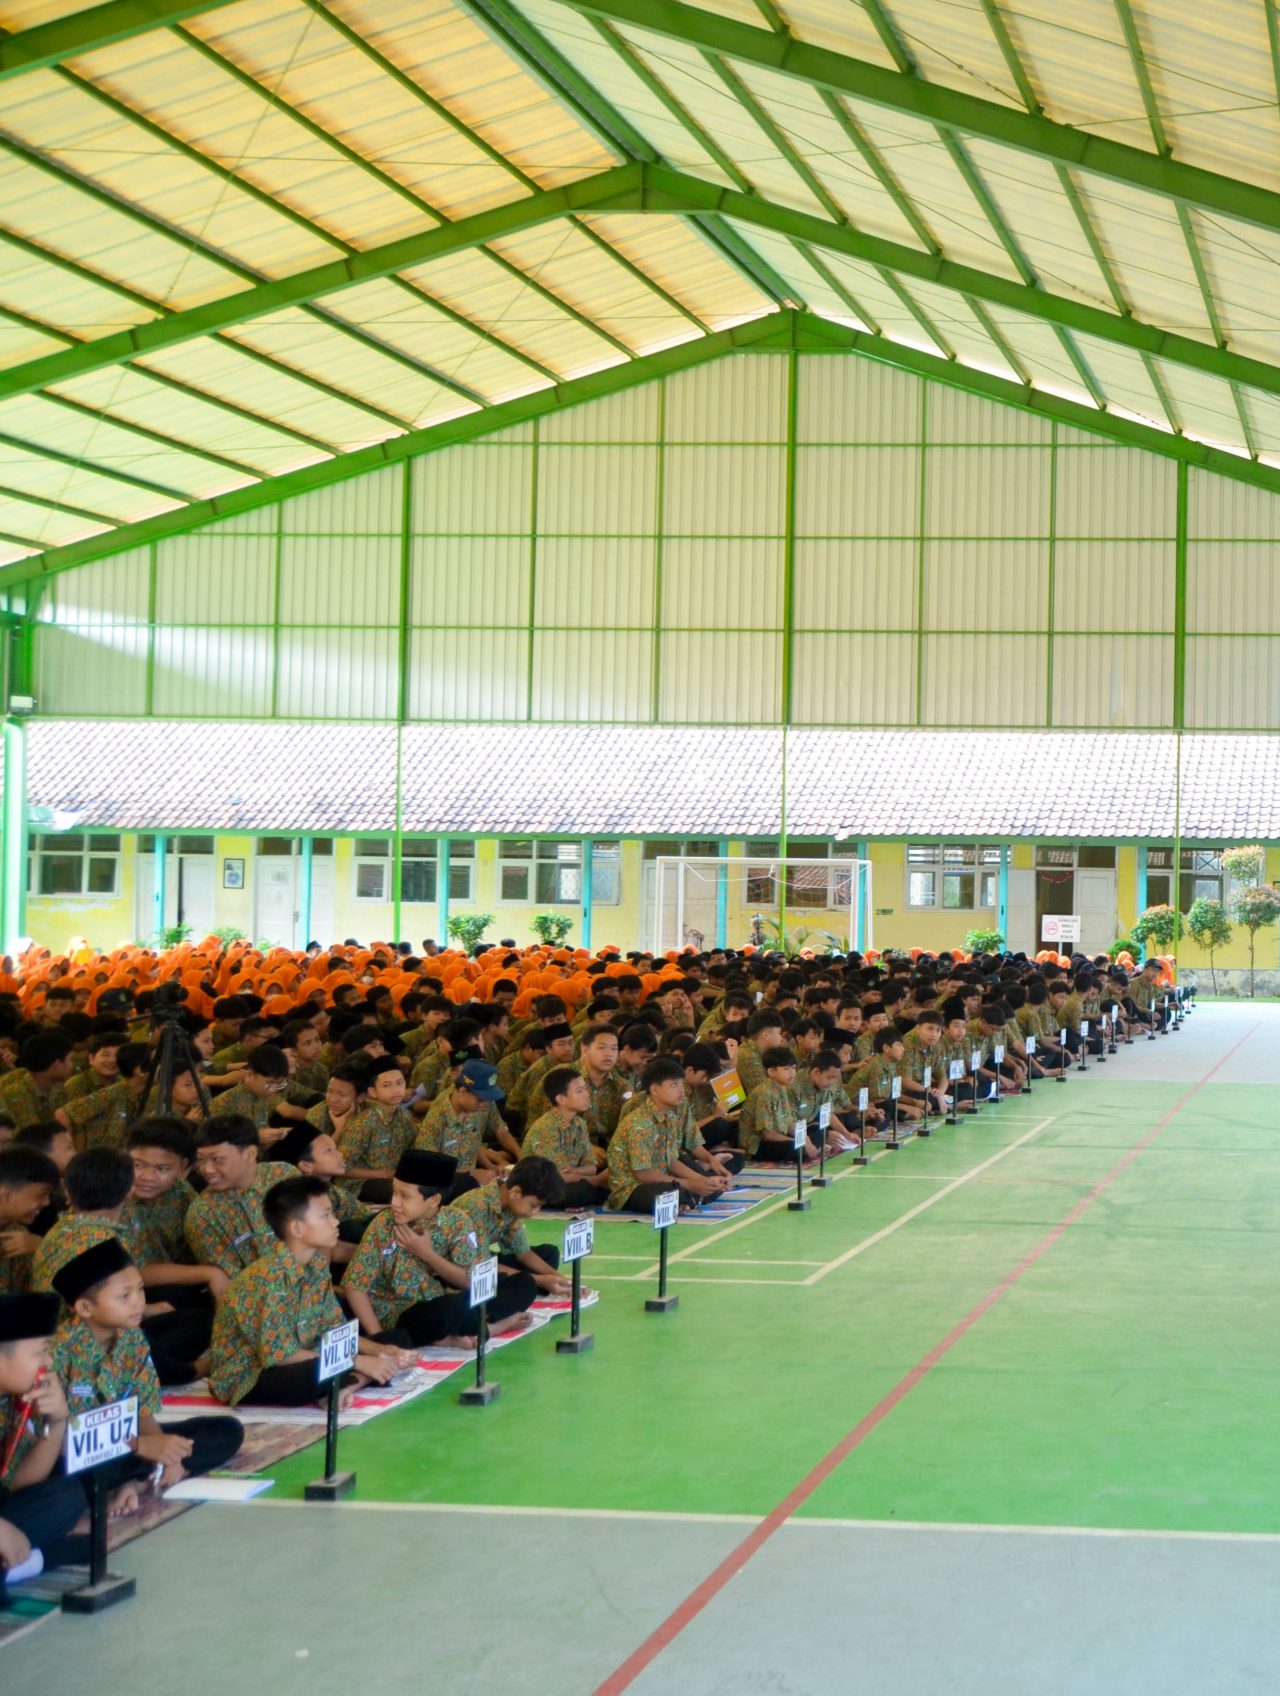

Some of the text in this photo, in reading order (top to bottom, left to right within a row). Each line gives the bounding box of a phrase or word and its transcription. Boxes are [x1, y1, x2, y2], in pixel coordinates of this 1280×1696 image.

[567, 1232, 592, 1256] VIII. B
[324, 1343, 341, 1368] VII.
[344, 1336, 357, 1359] U8
[86, 1406, 120, 1427] KELAS
[72, 1416, 134, 1458] VII. U7
